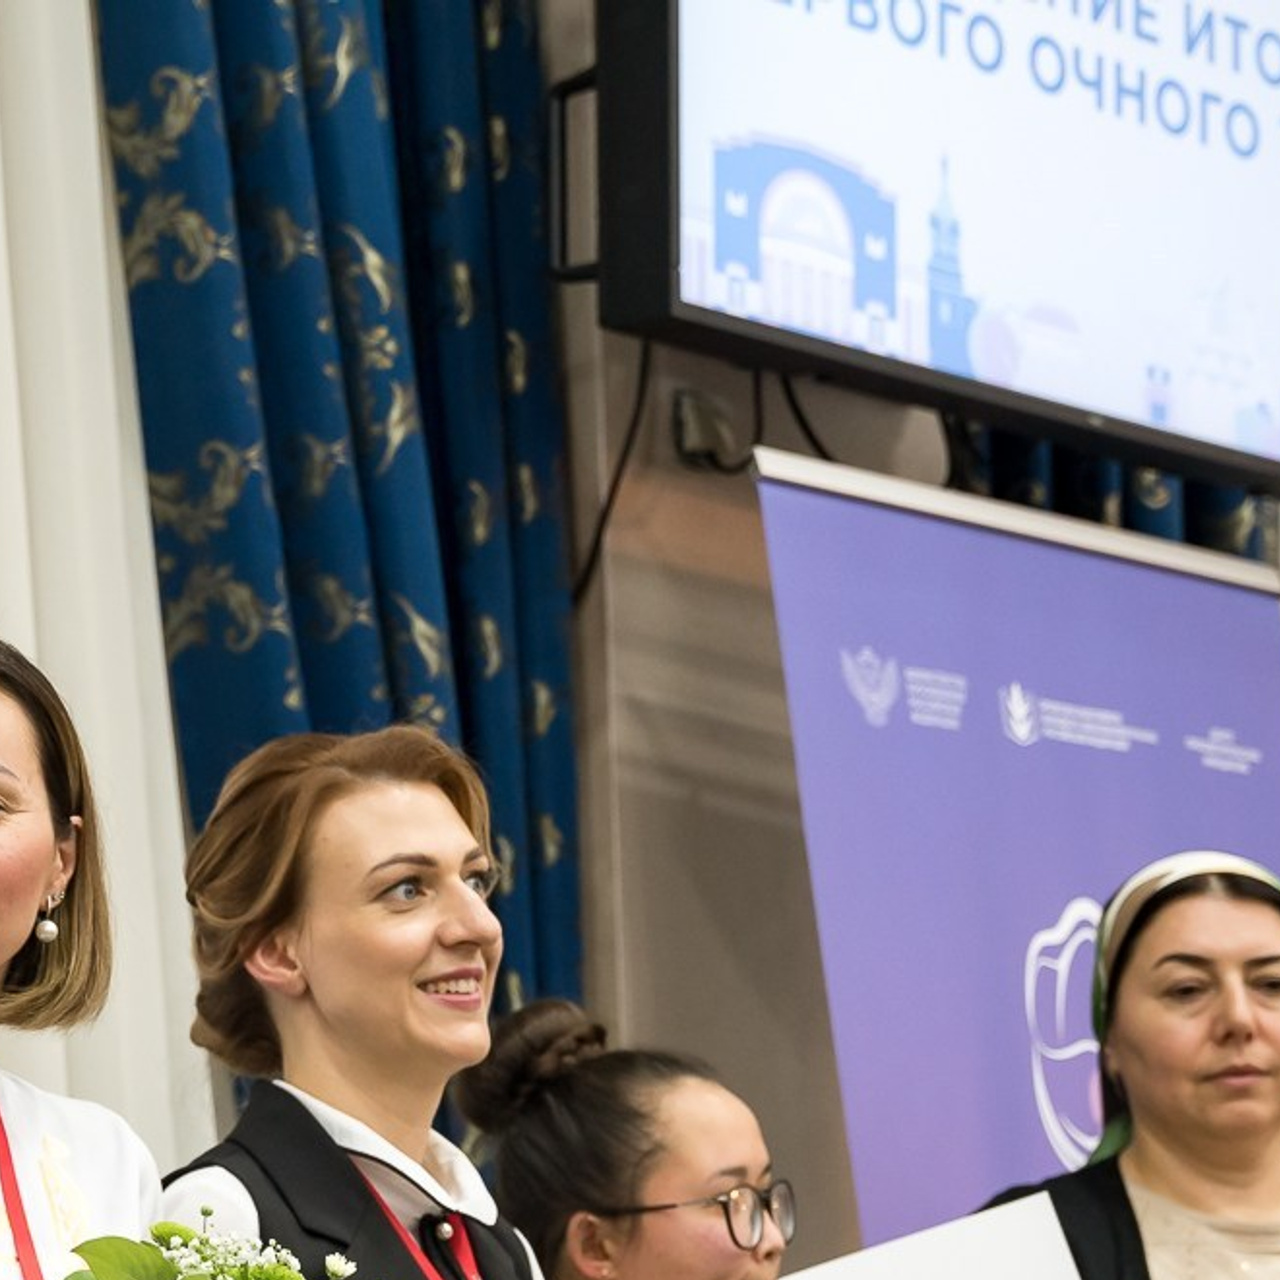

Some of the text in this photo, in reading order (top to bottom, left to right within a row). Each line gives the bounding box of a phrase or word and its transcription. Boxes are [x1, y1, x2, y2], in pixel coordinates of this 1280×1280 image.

[804, 0, 1260, 158] ВОГО ОЧНОГО
[1183, 2, 1280, 86] ИТО
